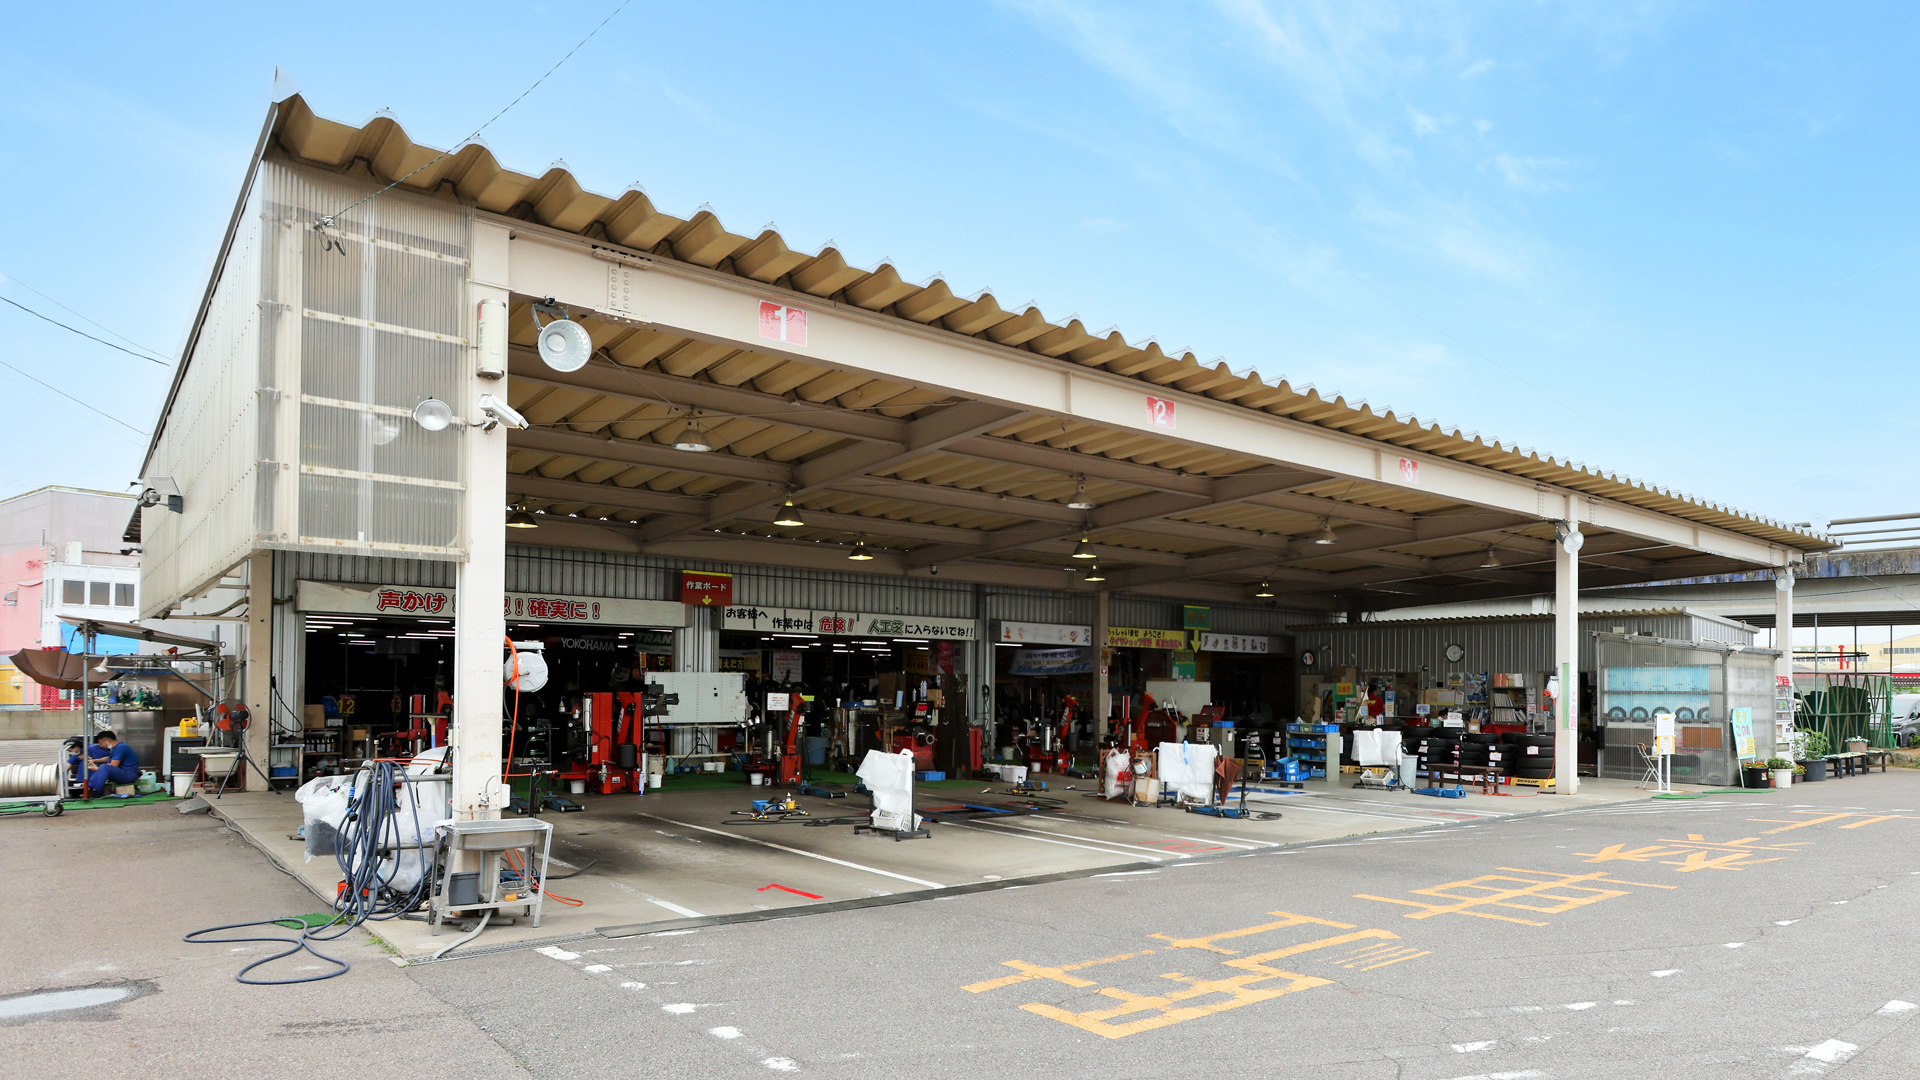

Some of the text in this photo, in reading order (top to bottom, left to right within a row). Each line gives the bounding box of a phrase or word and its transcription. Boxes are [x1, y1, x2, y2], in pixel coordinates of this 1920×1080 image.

[774, 306, 787, 341] 1
[1156, 401, 1167, 425] 2
[1405, 460, 1413, 482] 3
[686, 580, 727, 591] 作業ボード
[377, 588, 456, 615] 声かけ
[725, 607, 768, 620] お客様へ
[772, 617, 813, 631] 作業中は
[819, 617, 855, 633] 危険！
[1187, 610, 1207, 623] 受付
[561, 637, 616, 652] YOKOHAMA
[1016, 662, 1090, 673] BluEarth-GT
[337, 699, 356, 714] 12
